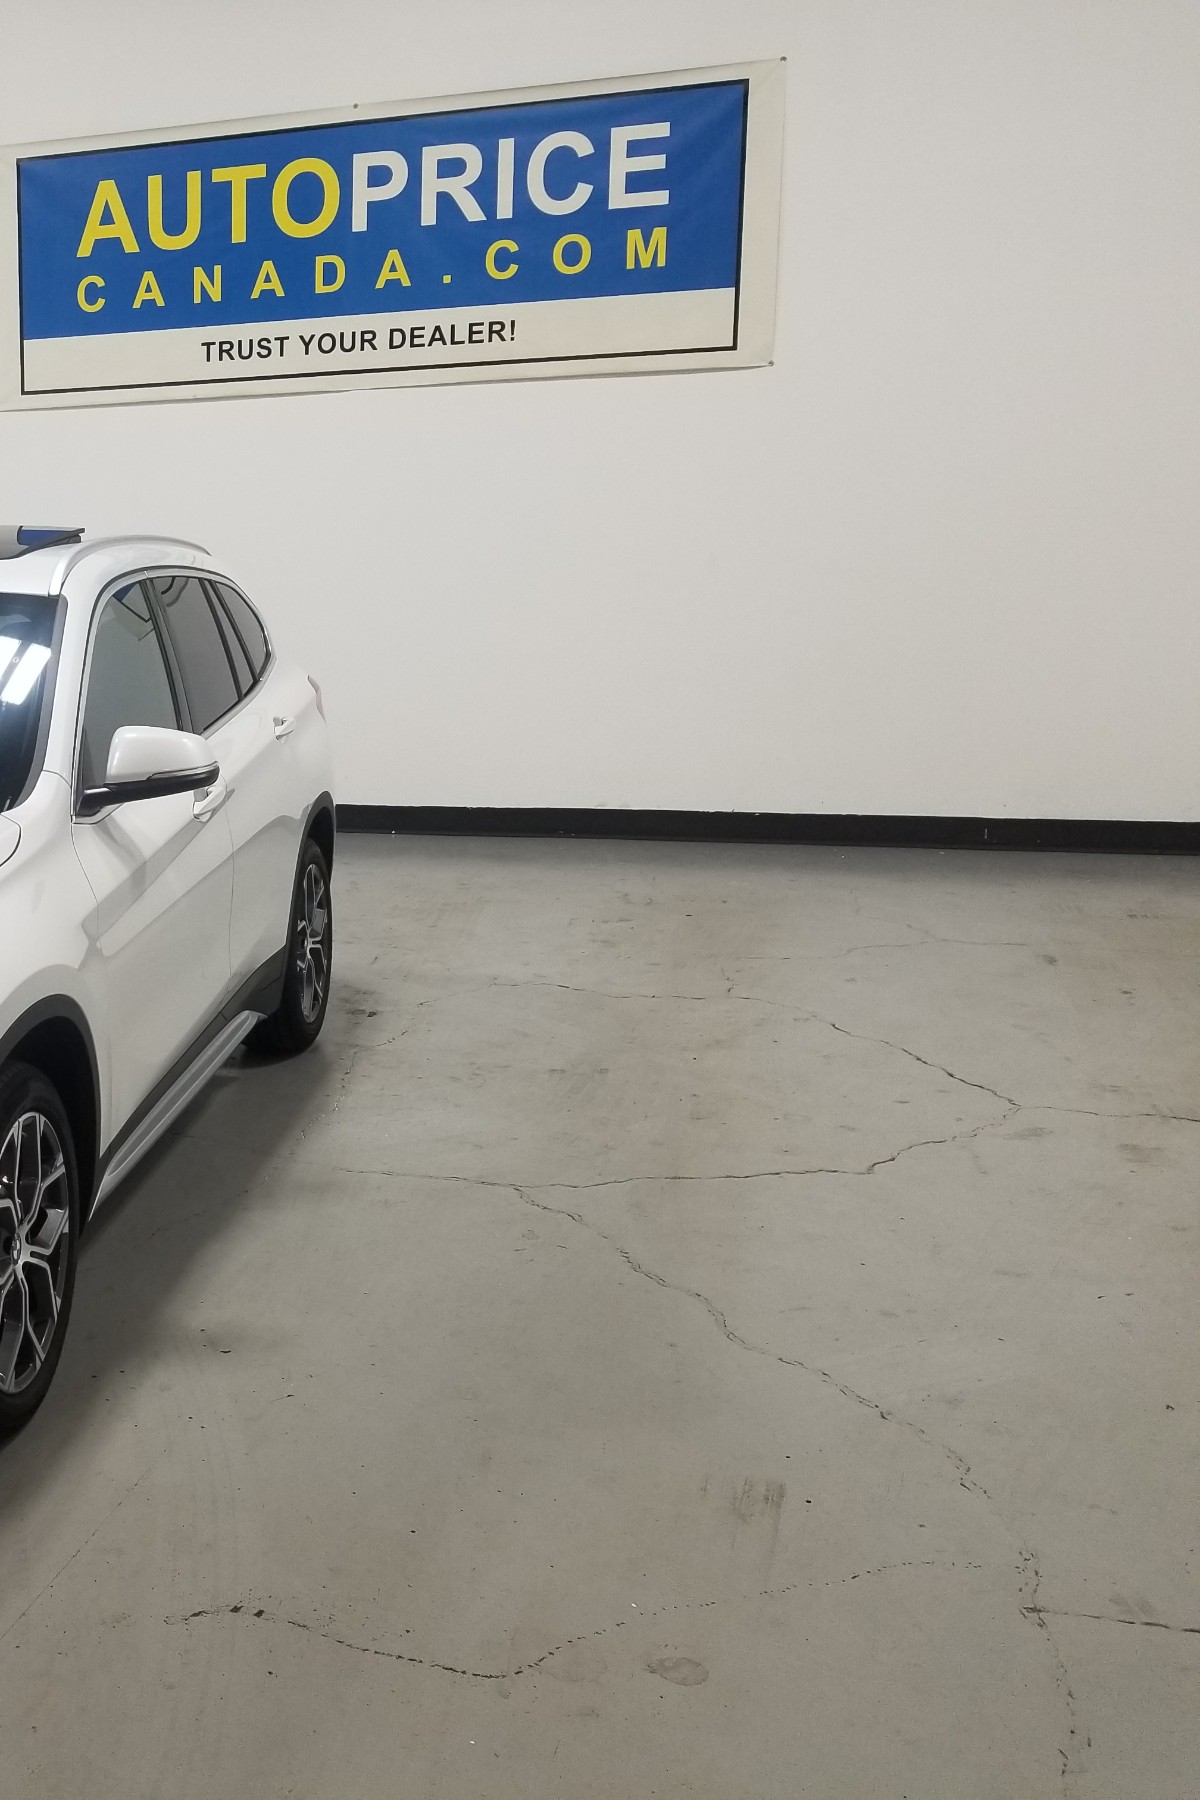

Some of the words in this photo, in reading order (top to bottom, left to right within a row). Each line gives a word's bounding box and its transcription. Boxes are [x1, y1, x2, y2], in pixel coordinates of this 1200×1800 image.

[76, 121, 671, 257] AUTOPRICE
[77, 226, 668, 313] CANADA.COM
[201, 336, 290, 363] TRUST
[299, 330, 378, 356] YOUR
[388, 320, 516, 350] DEALER!
